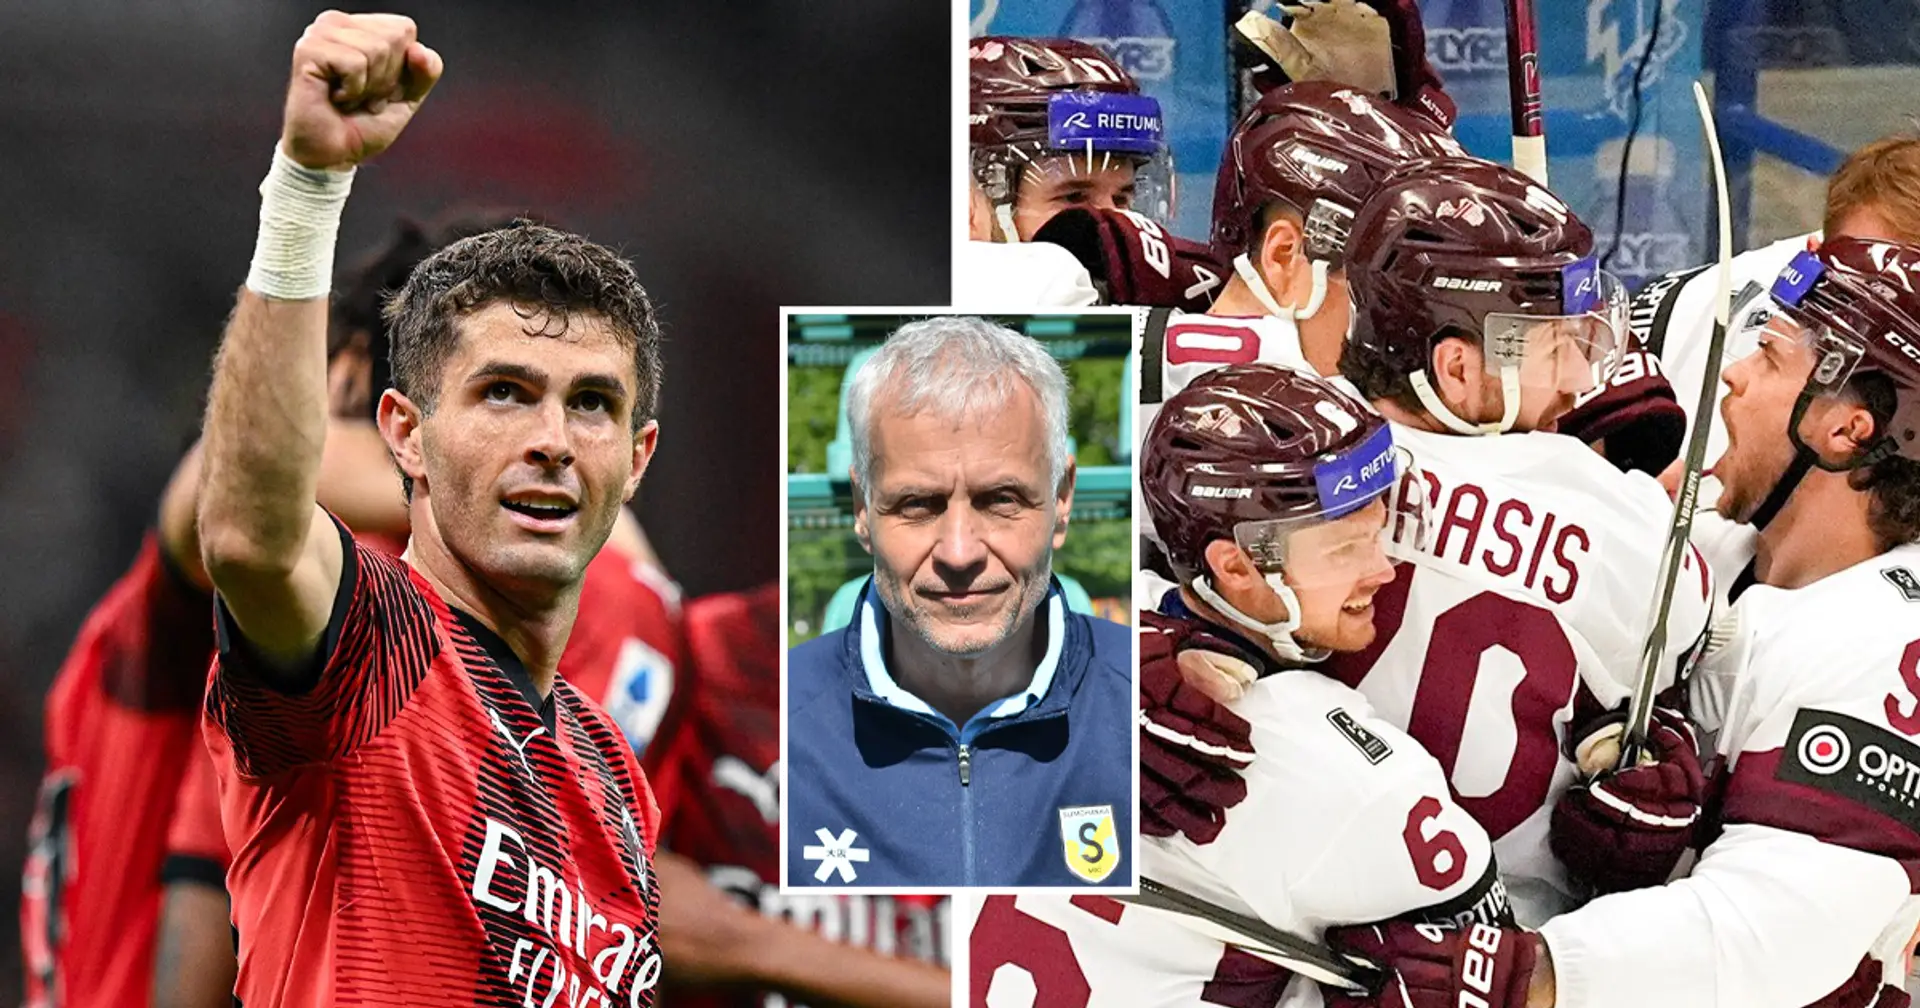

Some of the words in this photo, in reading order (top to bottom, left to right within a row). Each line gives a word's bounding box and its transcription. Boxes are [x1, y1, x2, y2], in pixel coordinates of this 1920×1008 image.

[1191, 485, 1253, 499] BAUER
[1079, 822, 1104, 864] S
[1403, 796, 1468, 891] 6
